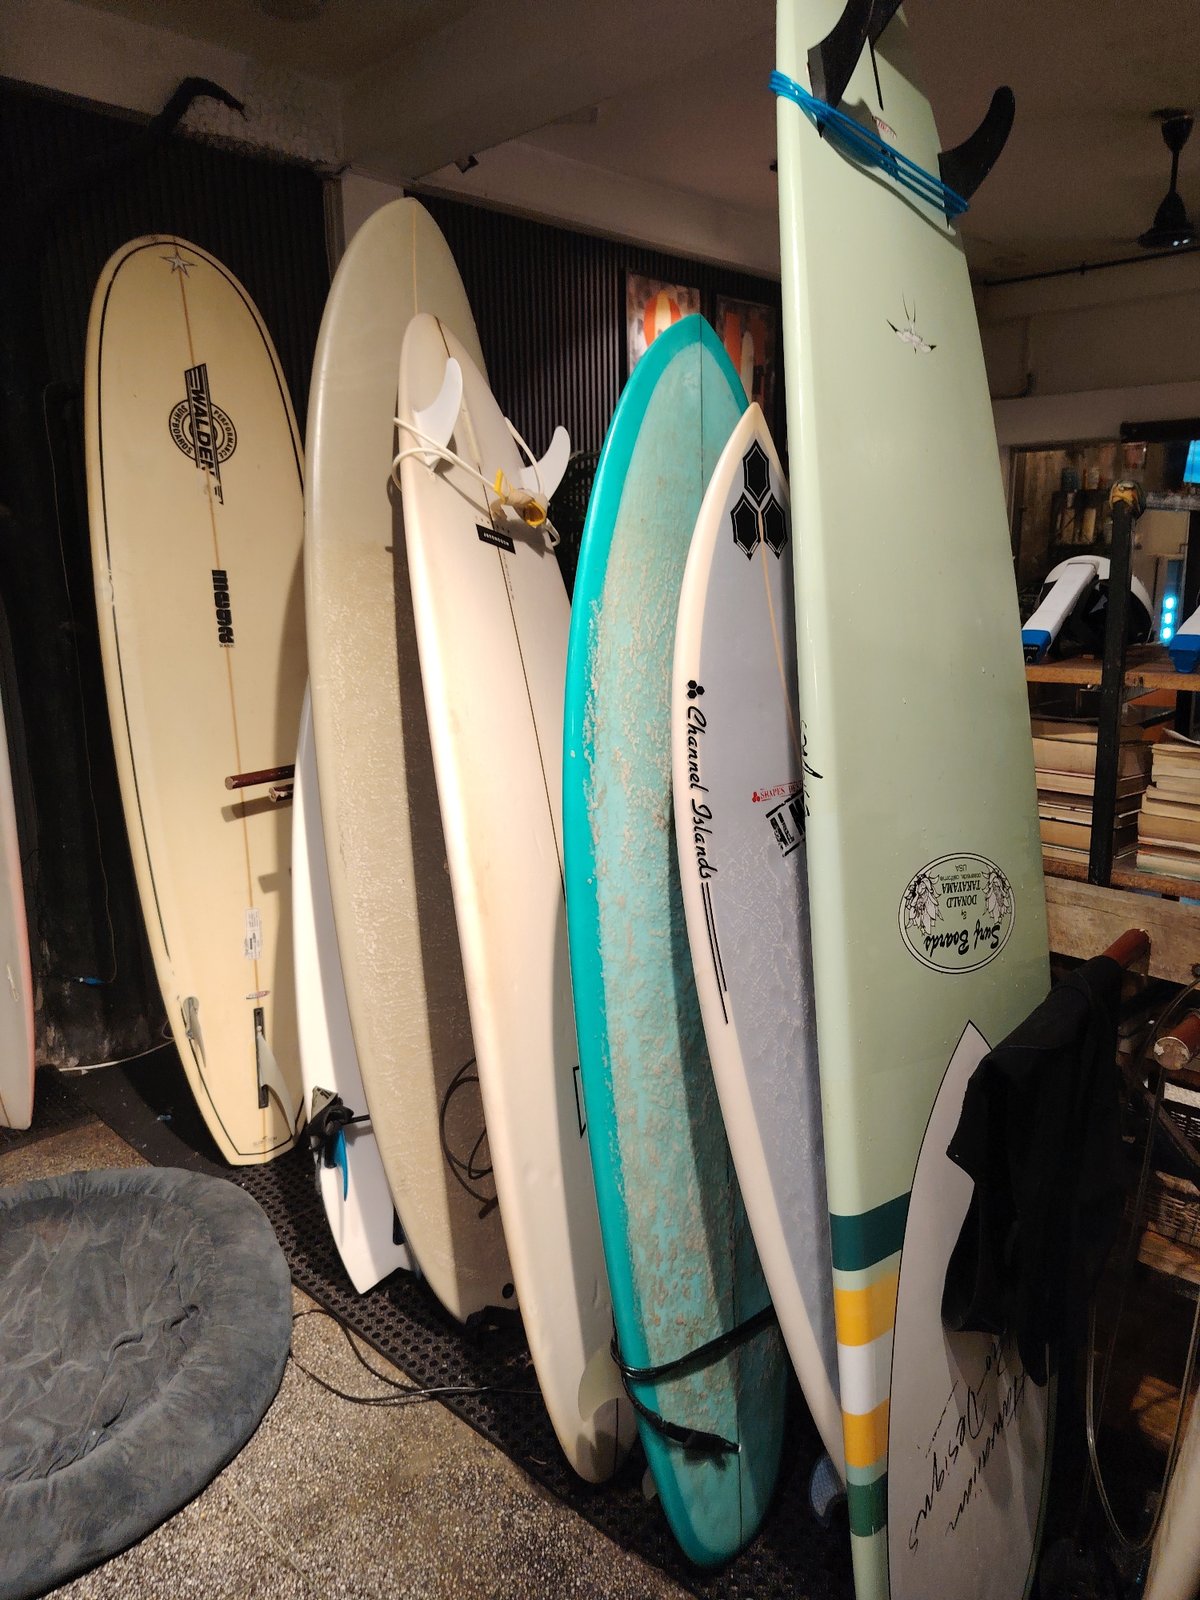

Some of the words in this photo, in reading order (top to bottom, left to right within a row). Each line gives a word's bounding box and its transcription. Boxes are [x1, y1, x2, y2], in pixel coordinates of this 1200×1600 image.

[171, 404, 194, 455] SURFBOARDS
[213, 408, 234, 459] PERFORMANCE
[687, 705, 709, 793] Channel
[691, 798, 718, 879] Islands
[954, 864, 968, 872] USA
[942, 880, 981, 894] TAKAYAMA
[946, 895, 977, 908] DONALD
[923, 929, 970, 958] Boards
[974, 919, 1001, 950] Surf
